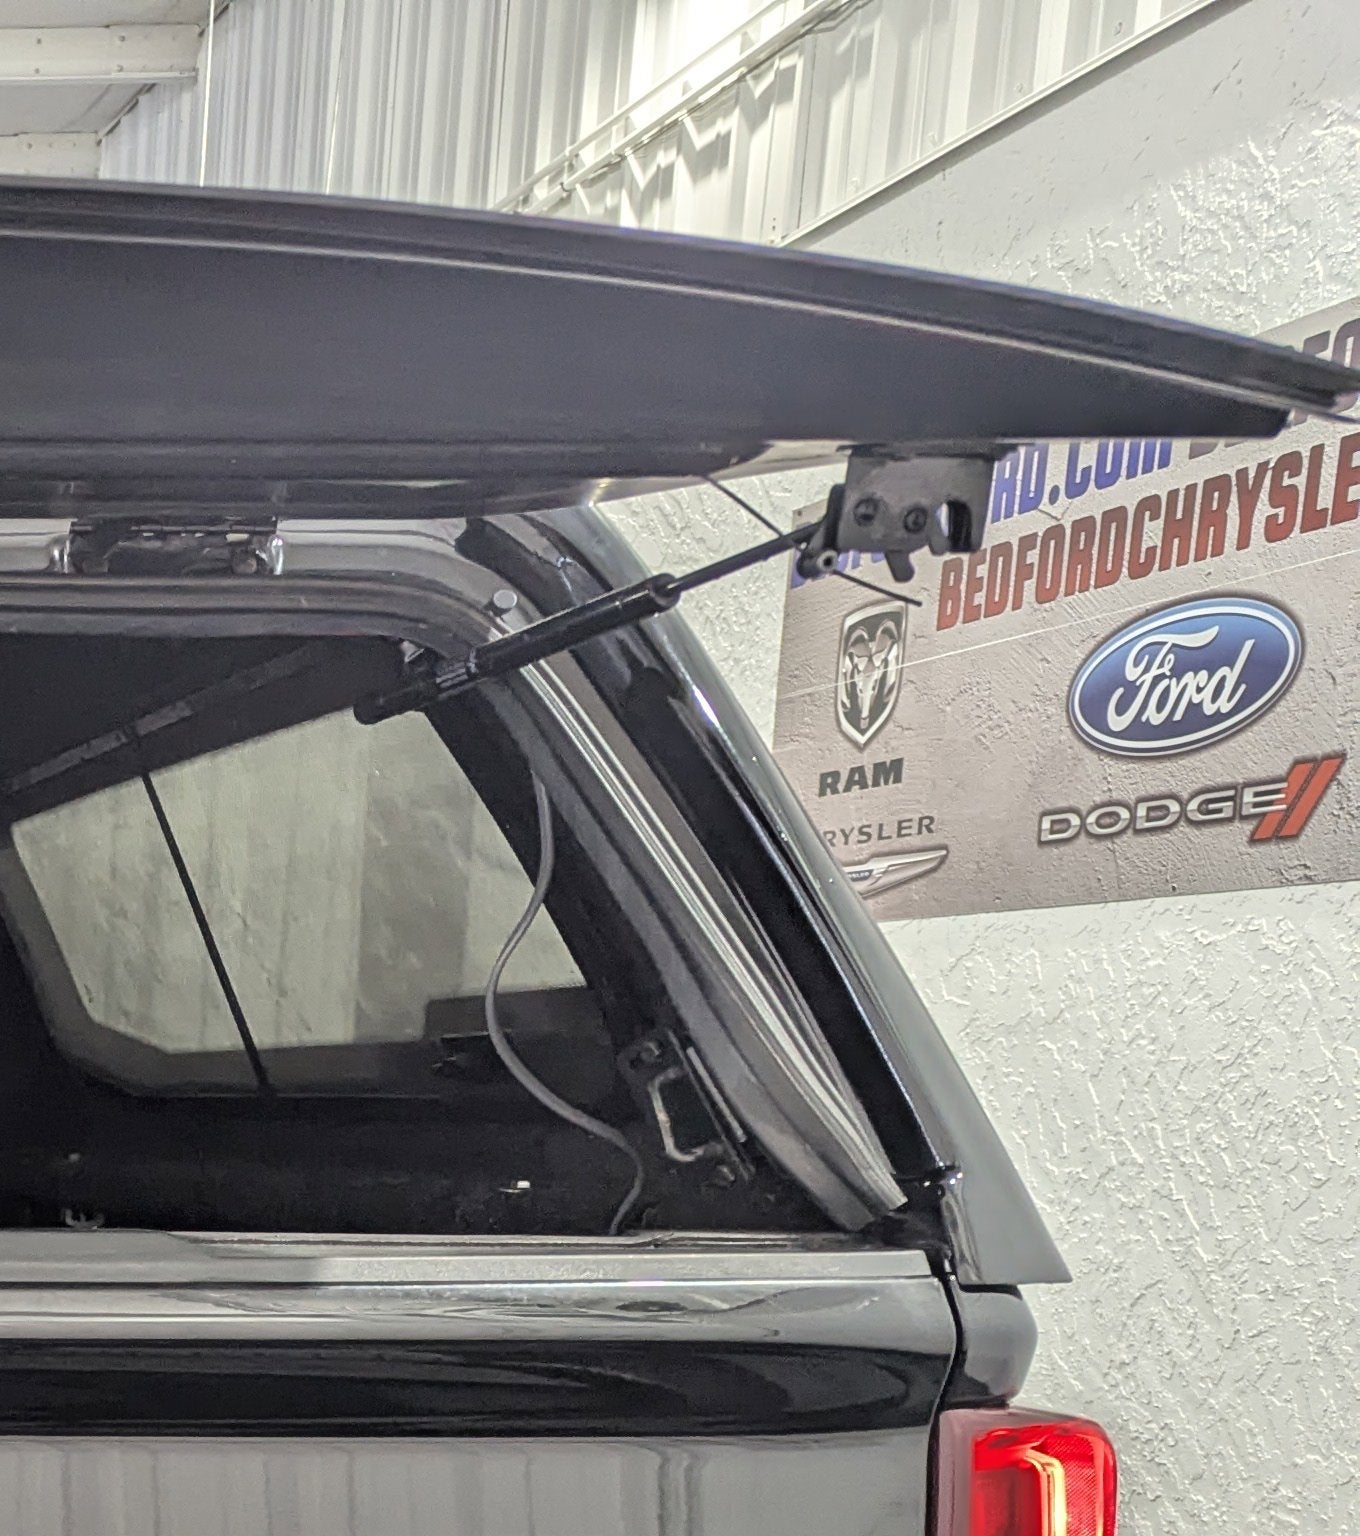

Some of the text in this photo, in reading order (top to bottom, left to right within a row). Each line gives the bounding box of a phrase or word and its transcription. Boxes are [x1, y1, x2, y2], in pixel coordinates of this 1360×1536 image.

[1107, 625, 1255, 732] Ford
[818, 757, 905, 797] RAM
[822, 815, 936, 848] RYSLER
[1039, 781, 1289, 843] DODGE
